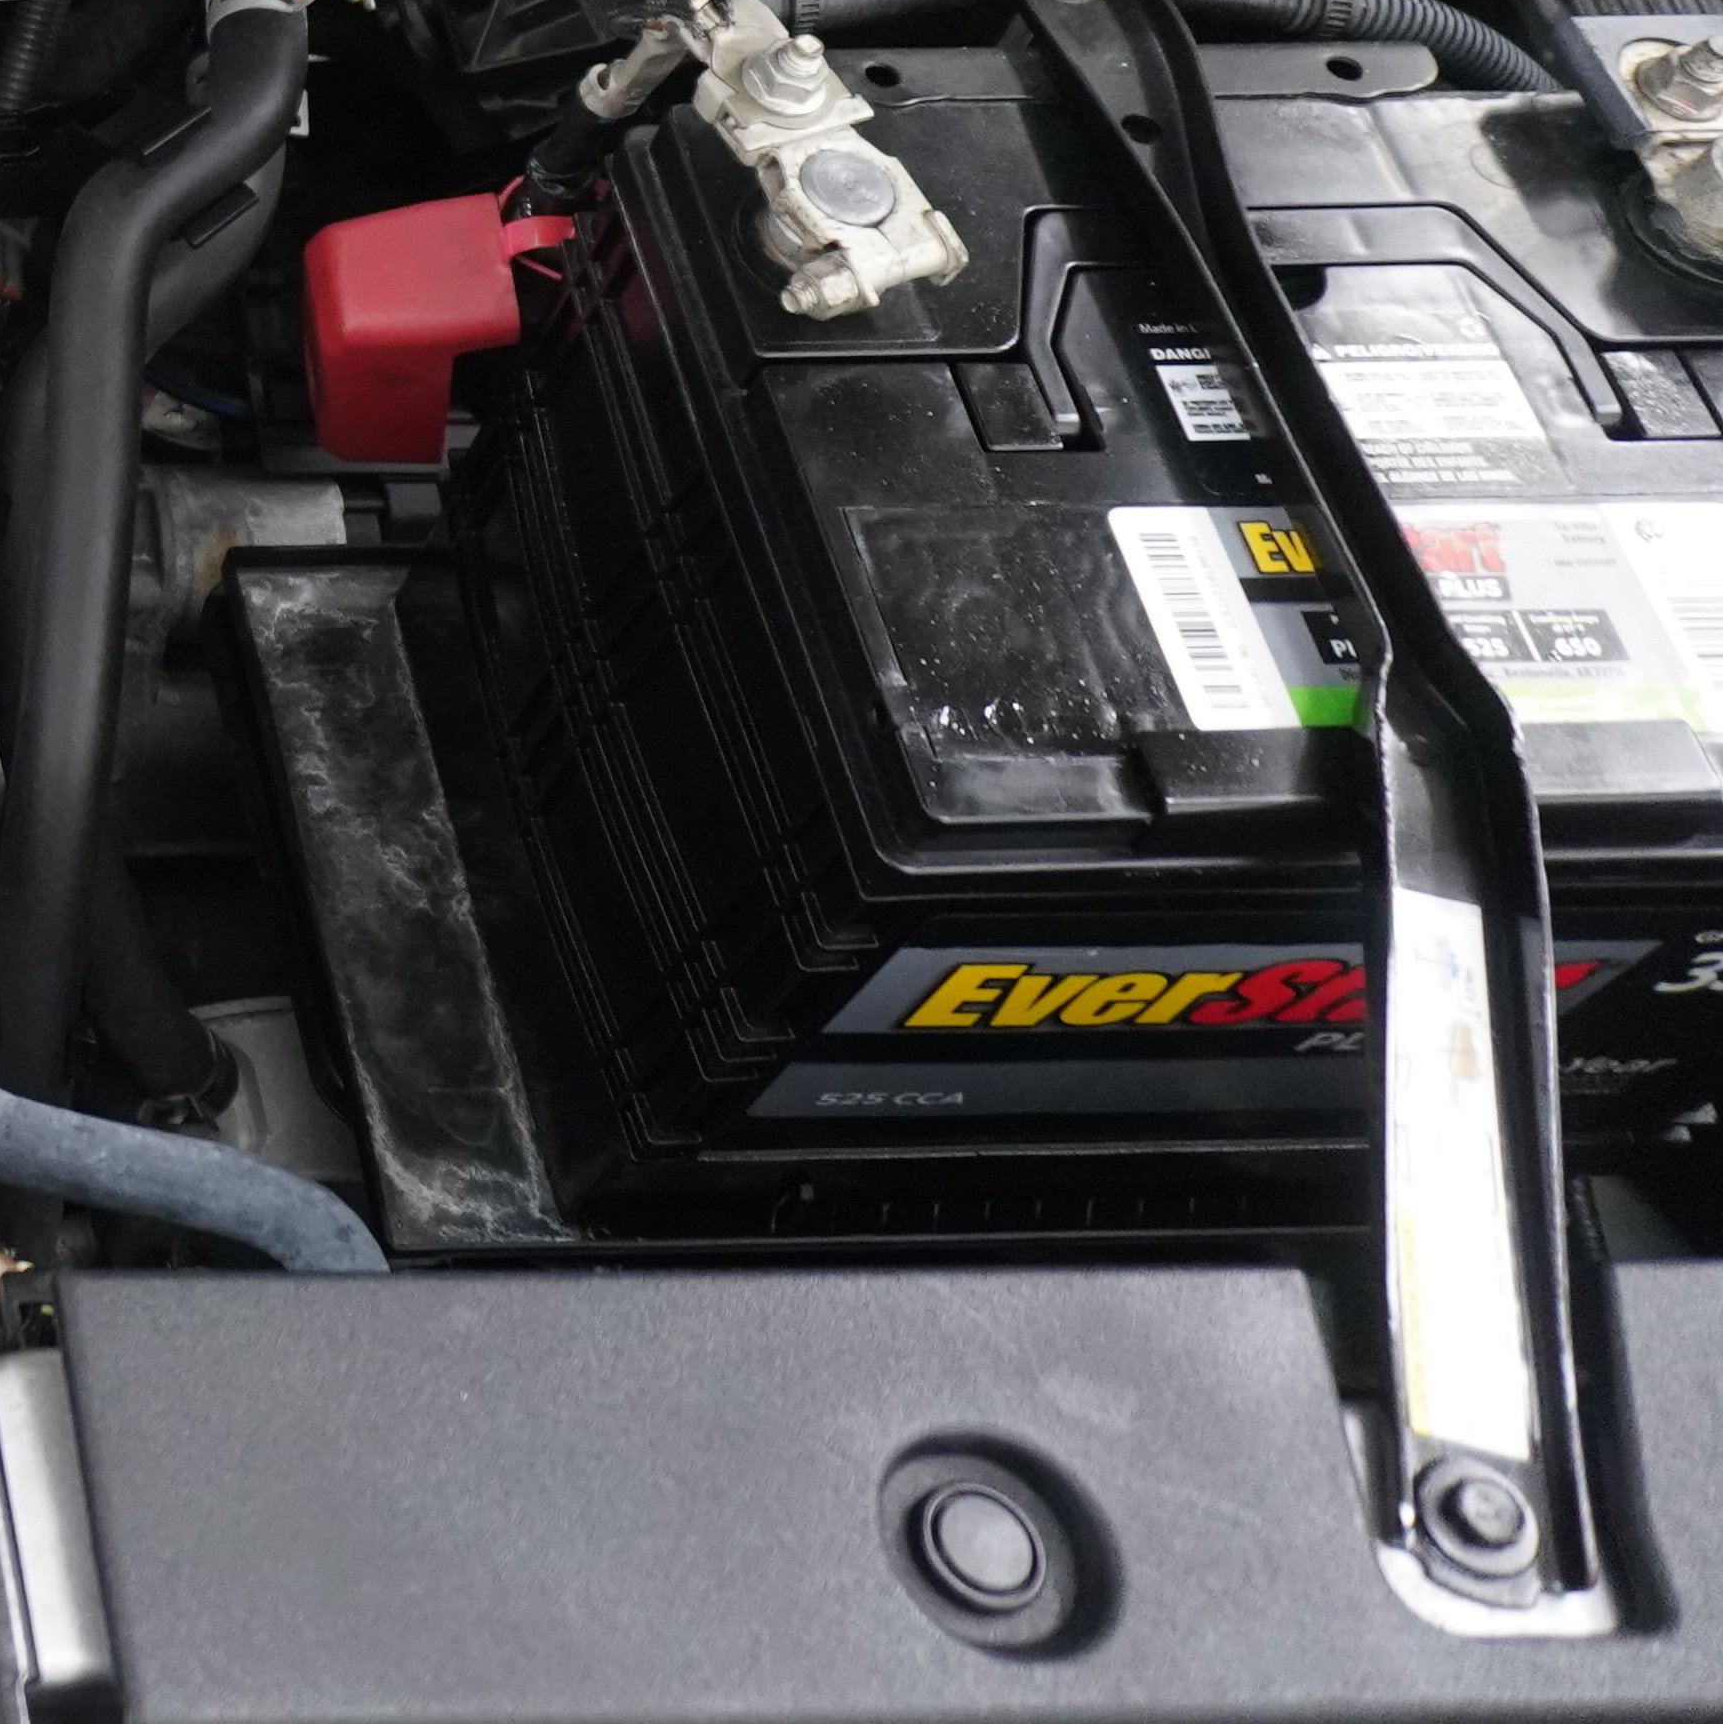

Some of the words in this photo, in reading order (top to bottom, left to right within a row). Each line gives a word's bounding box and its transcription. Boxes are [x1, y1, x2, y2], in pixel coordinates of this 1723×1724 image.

[1149, 347, 1211, 361] DANG
[1437, 577, 1504, 599] PLUS
[1460, 637, 1510, 658] 525
[1555, 637, 1602, 658] 650
[901, 958, 1368, 1030] EverSt
[1294, 1031, 1367, 1053] PL
[892, 1090, 965, 1106] CCA
